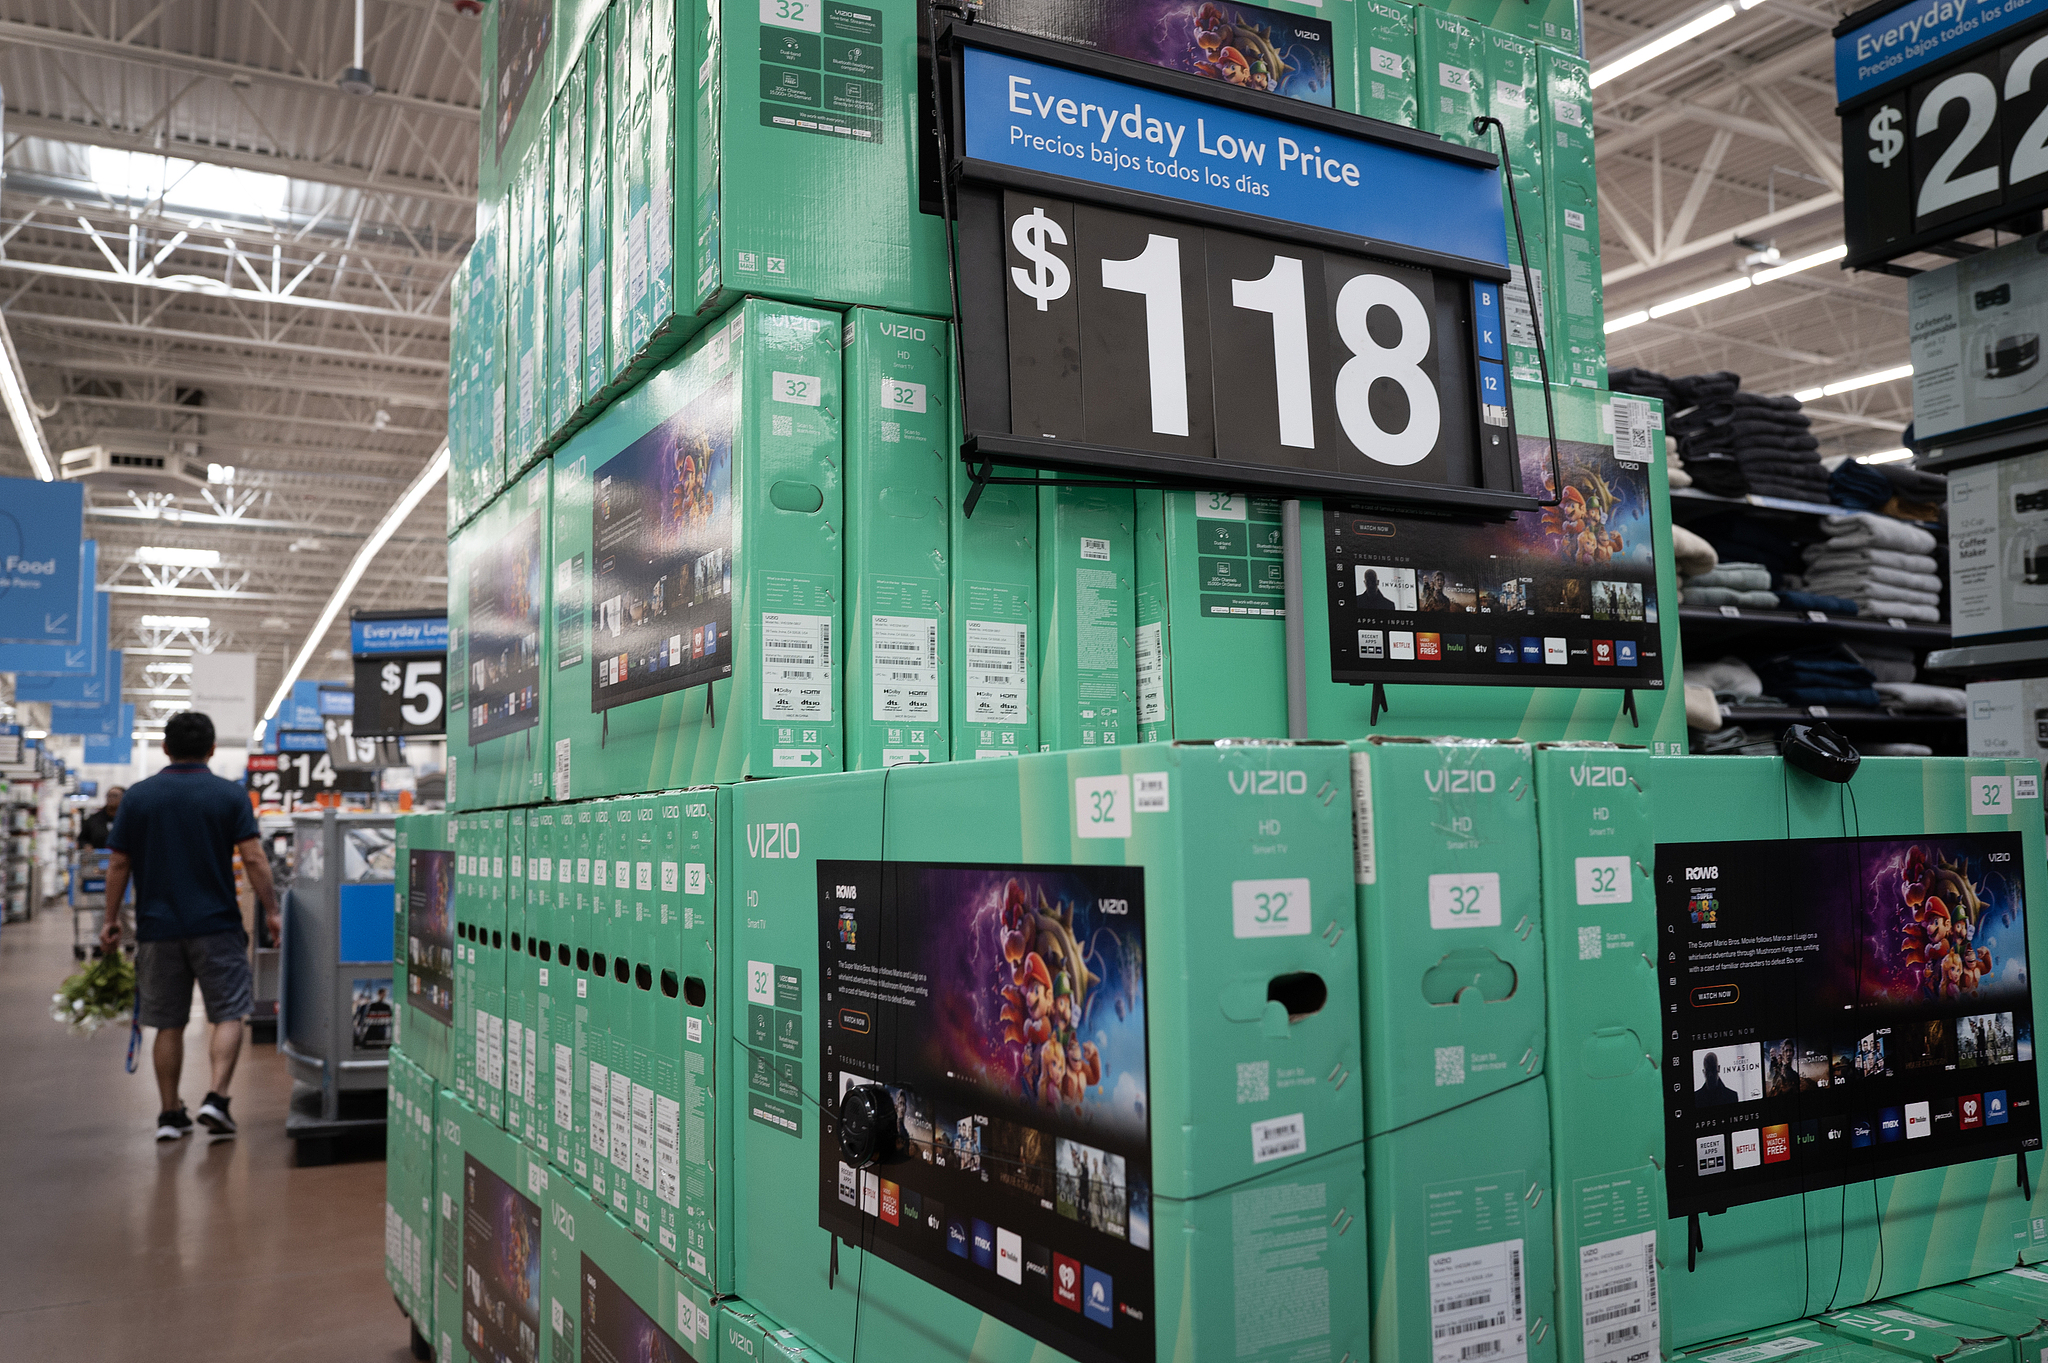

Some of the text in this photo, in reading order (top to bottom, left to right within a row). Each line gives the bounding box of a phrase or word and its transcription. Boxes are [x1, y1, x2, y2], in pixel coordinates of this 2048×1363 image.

[835, 9, 853, 18] VIZIO
[1368, 3, 1400, 21] VIZIO
[1294, 28, 1320, 42] VIZIO
[1857, 0, 1968, 61] Everyday
[1858, 51, 1903, 80] Precios
[1905, 36, 1939, 60] bajos
[1940, 16, 1979, 42] todos
[1981, 7, 2002, 23] los
[1008, 75, 1361, 188] Everyday Low Price
[1010, 125, 1271, 197] Precios bajos todos los días
[1482, 293, 1491, 306] B
[880, 322, 926, 342] VIZIO
[1483, 330, 1493, 344] K
[898, 350, 911, 360] HD
[1484, 376, 1497, 391] 12
[1619, 462, 1639, 470] VIZIO
[1959, 538, 1987, 549] Coffee
[1354, 553, 1391, 561] TRENDING
[1960, 549, 1986, 559] Maker
[6, 555, 56, 575] Food
[362, 624, 422, 640] Everyday
[1393, 641, 1411, 649] NETFLIX
[1447, 643, 1463, 651] hulu
[381, 661, 443, 725] $5
[277, 753, 337, 788] $14
[1570, 766, 1627, 787] VIZIO
[1228, 770, 1308, 795] VIZIO
[1424, 769, 1496, 793] VIZIO
[662, 805, 680, 819] VIZIO
[686, 803, 706, 818] VIZIO
[1593, 808, 1609, 821] HD
[1258, 820, 1281, 835] HD
[1452, 817, 1472, 832] HD
[1589, 828, 1606, 836] Smart
[747, 822, 800, 859] VIZIO
[1252, 844, 1288, 854] Smart TV
[1988, 852, 2010, 862] VIZIO
[1685, 866, 1719, 881] ROW8
[747, 890, 759, 908] HD
[836, 885, 857, 900] ROW8
[1099, 898, 1128, 915] VIZIO
[1688, 899, 1719, 912] MARIO
[747, 918, 760, 930] Smart
[1688, 941, 1698, 949] The
[1698, 940, 1713, 949] Super
[1713, 939, 1728, 947] Mario
[1741, 937, 1755, 945] Movie
[1755, 935, 1772, 943] follows
[1712, 951, 1736, 959] adventure
[1737, 949, 1755, 957] through
[1756, 947, 1781, 955] Mushroom
[1740, 960, 1765, 968] characters
[1698, 992, 1717, 1000] WATCH
[1692, 1028, 1755, 1041] TRENDING NOW
[839, 1054, 865, 1069] TRENDING
[1723, 1063, 1760, 1074] INVASION
[1834, 1076, 1845, 1085] ion
[1695, 1113, 1760, 1129] APPS INPUTS
[1882, 1120, 1899, 1130] max
[1700, 1140, 1720, 1148] RECENT
[1766, 1137, 1786, 1145] WATCH
[1704, 1147, 1718, 1155] APPS
[1736, 1143, 1756, 1154] NETFLIX
[1767, 1145, 1787, 1156] FREE+
[904, 1203, 918, 1220] hulu
[552, 1199, 575, 1241] VIZIO
[1583, 1248, 1598, 1257] VIZIO
[729, 1328, 753, 1356] VIZIO
